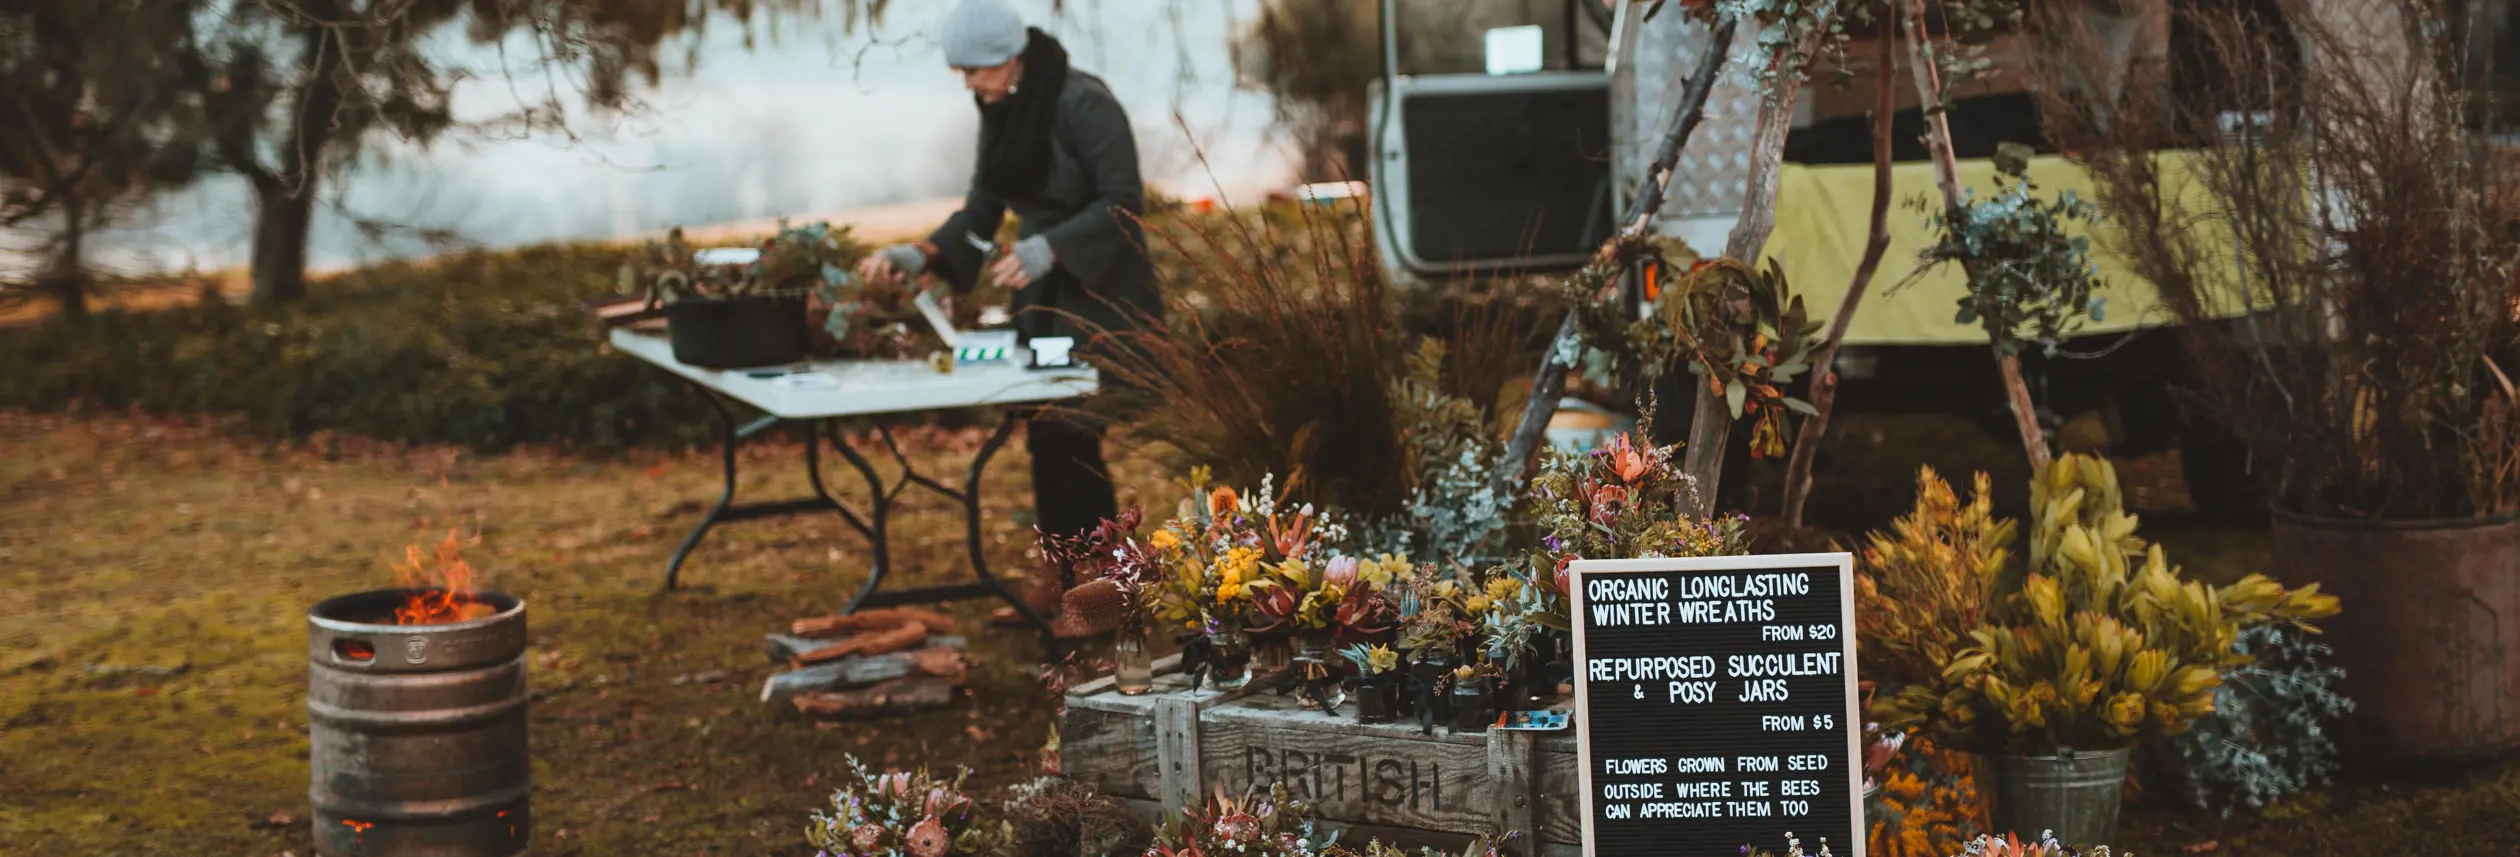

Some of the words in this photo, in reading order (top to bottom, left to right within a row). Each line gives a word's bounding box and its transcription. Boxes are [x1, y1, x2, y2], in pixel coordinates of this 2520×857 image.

[1589, 578, 1668, 601] ORGANIC
[1681, 573, 1809, 599] LONGLASTING
[1593, 602, 1670, 626] WINTER
[1679, 599, 1775, 623] WREATHS
[1763, 625, 1803, 641] FROM
[1809, 624, 1835, 639] $20
[1589, 656, 1715, 681] REPURPOSED
[1728, 652, 1841, 677] SUCCULENT
[1634, 684, 1644, 699] &
[1669, 681, 1716, 704] POSY
[1739, 679, 1788, 702] JARS
[1763, 716, 1804, 731] FROM
[1813, 715, 1833, 730] $5
[1606, 758, 1667, 775] FLOWERS
[1678, 757, 1725, 773] GROWN
[1738, 756, 1778, 772] FROM
[1788, 755, 1827, 770] SEED
[1246, 745, 1440, 811] BRITISH
[1605, 783, 1663, 799] OUTSIDE
[1677, 782, 1731, 798] WHERE
[1741, 781, 1769, 797] THE
[1782, 780, 1820, 795] BEES
[1606, 804, 1630, 819] CAN
[1640, 802, 1722, 818] APPRECIATE
[1727, 801, 1771, 817] THEM
[1780, 800, 1808, 816] TOO
